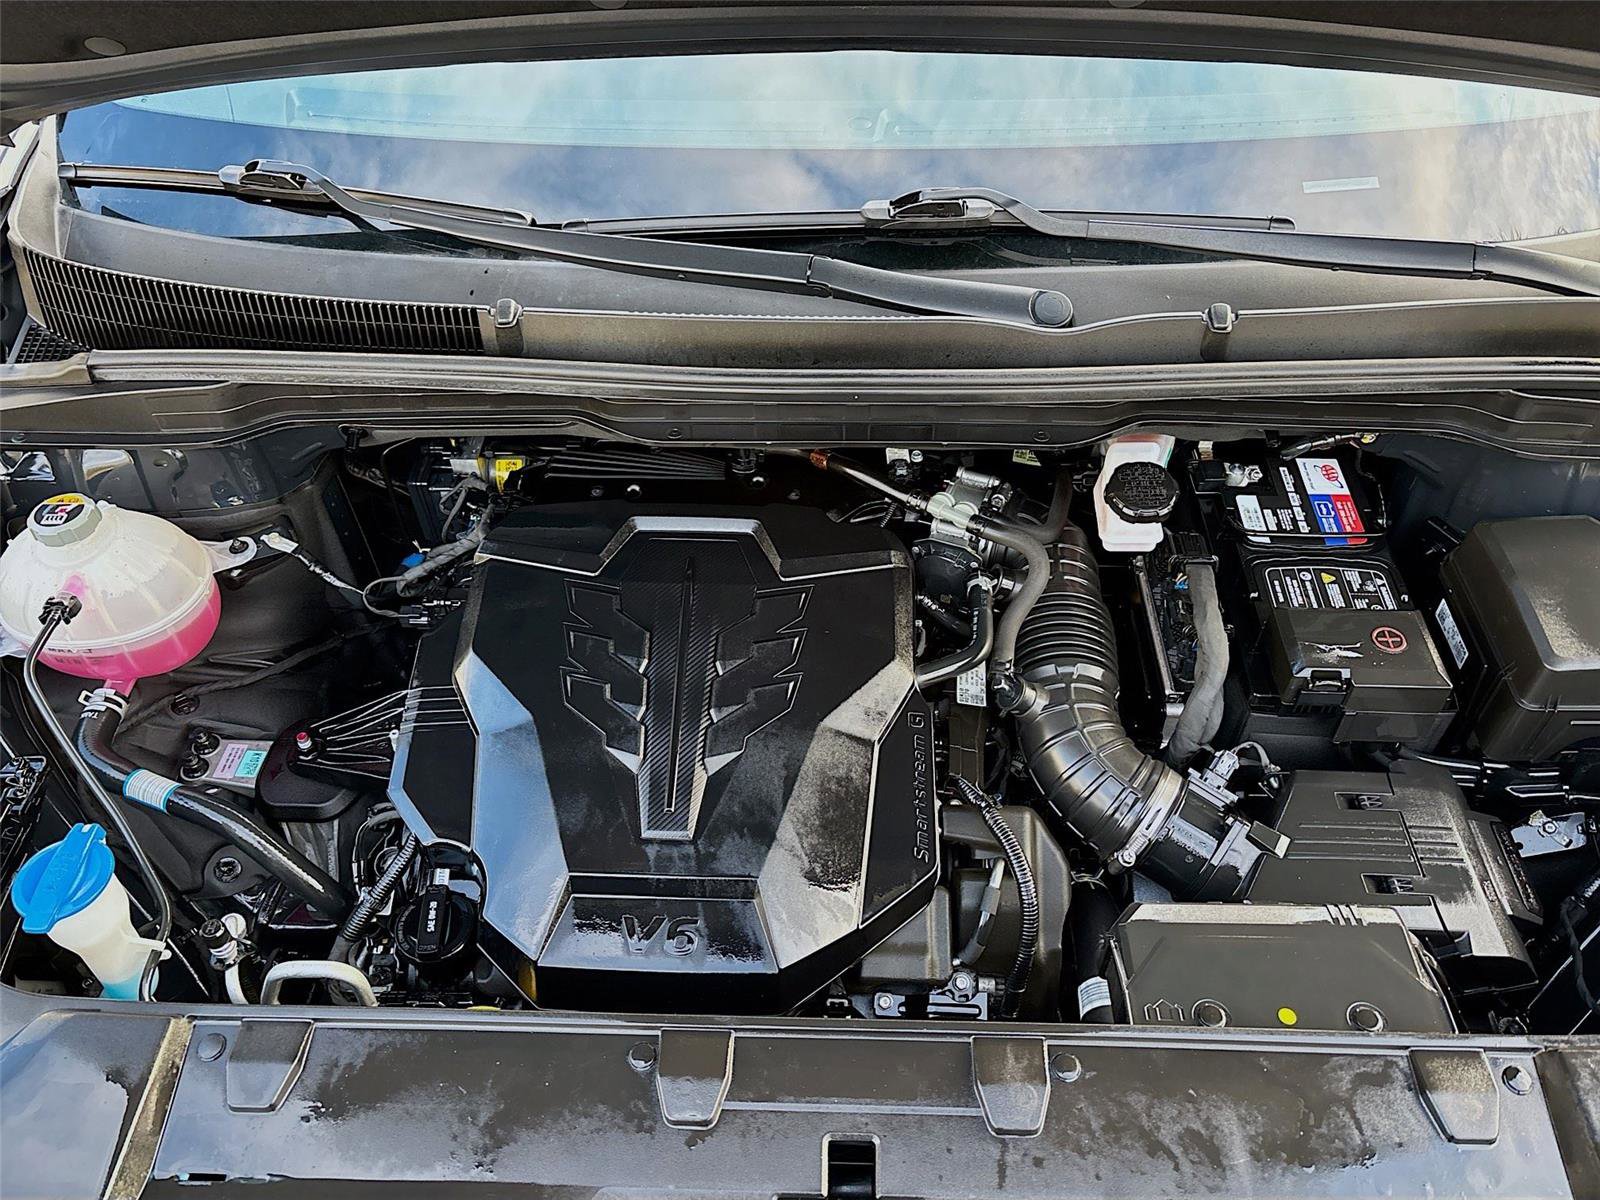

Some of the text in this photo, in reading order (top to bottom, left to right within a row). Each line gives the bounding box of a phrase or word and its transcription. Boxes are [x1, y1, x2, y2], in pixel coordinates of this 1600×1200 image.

[913, 734, 929, 864] Smartstream
[426, 919, 436, 932] SAE
[621, 914, 700, 957] V6
